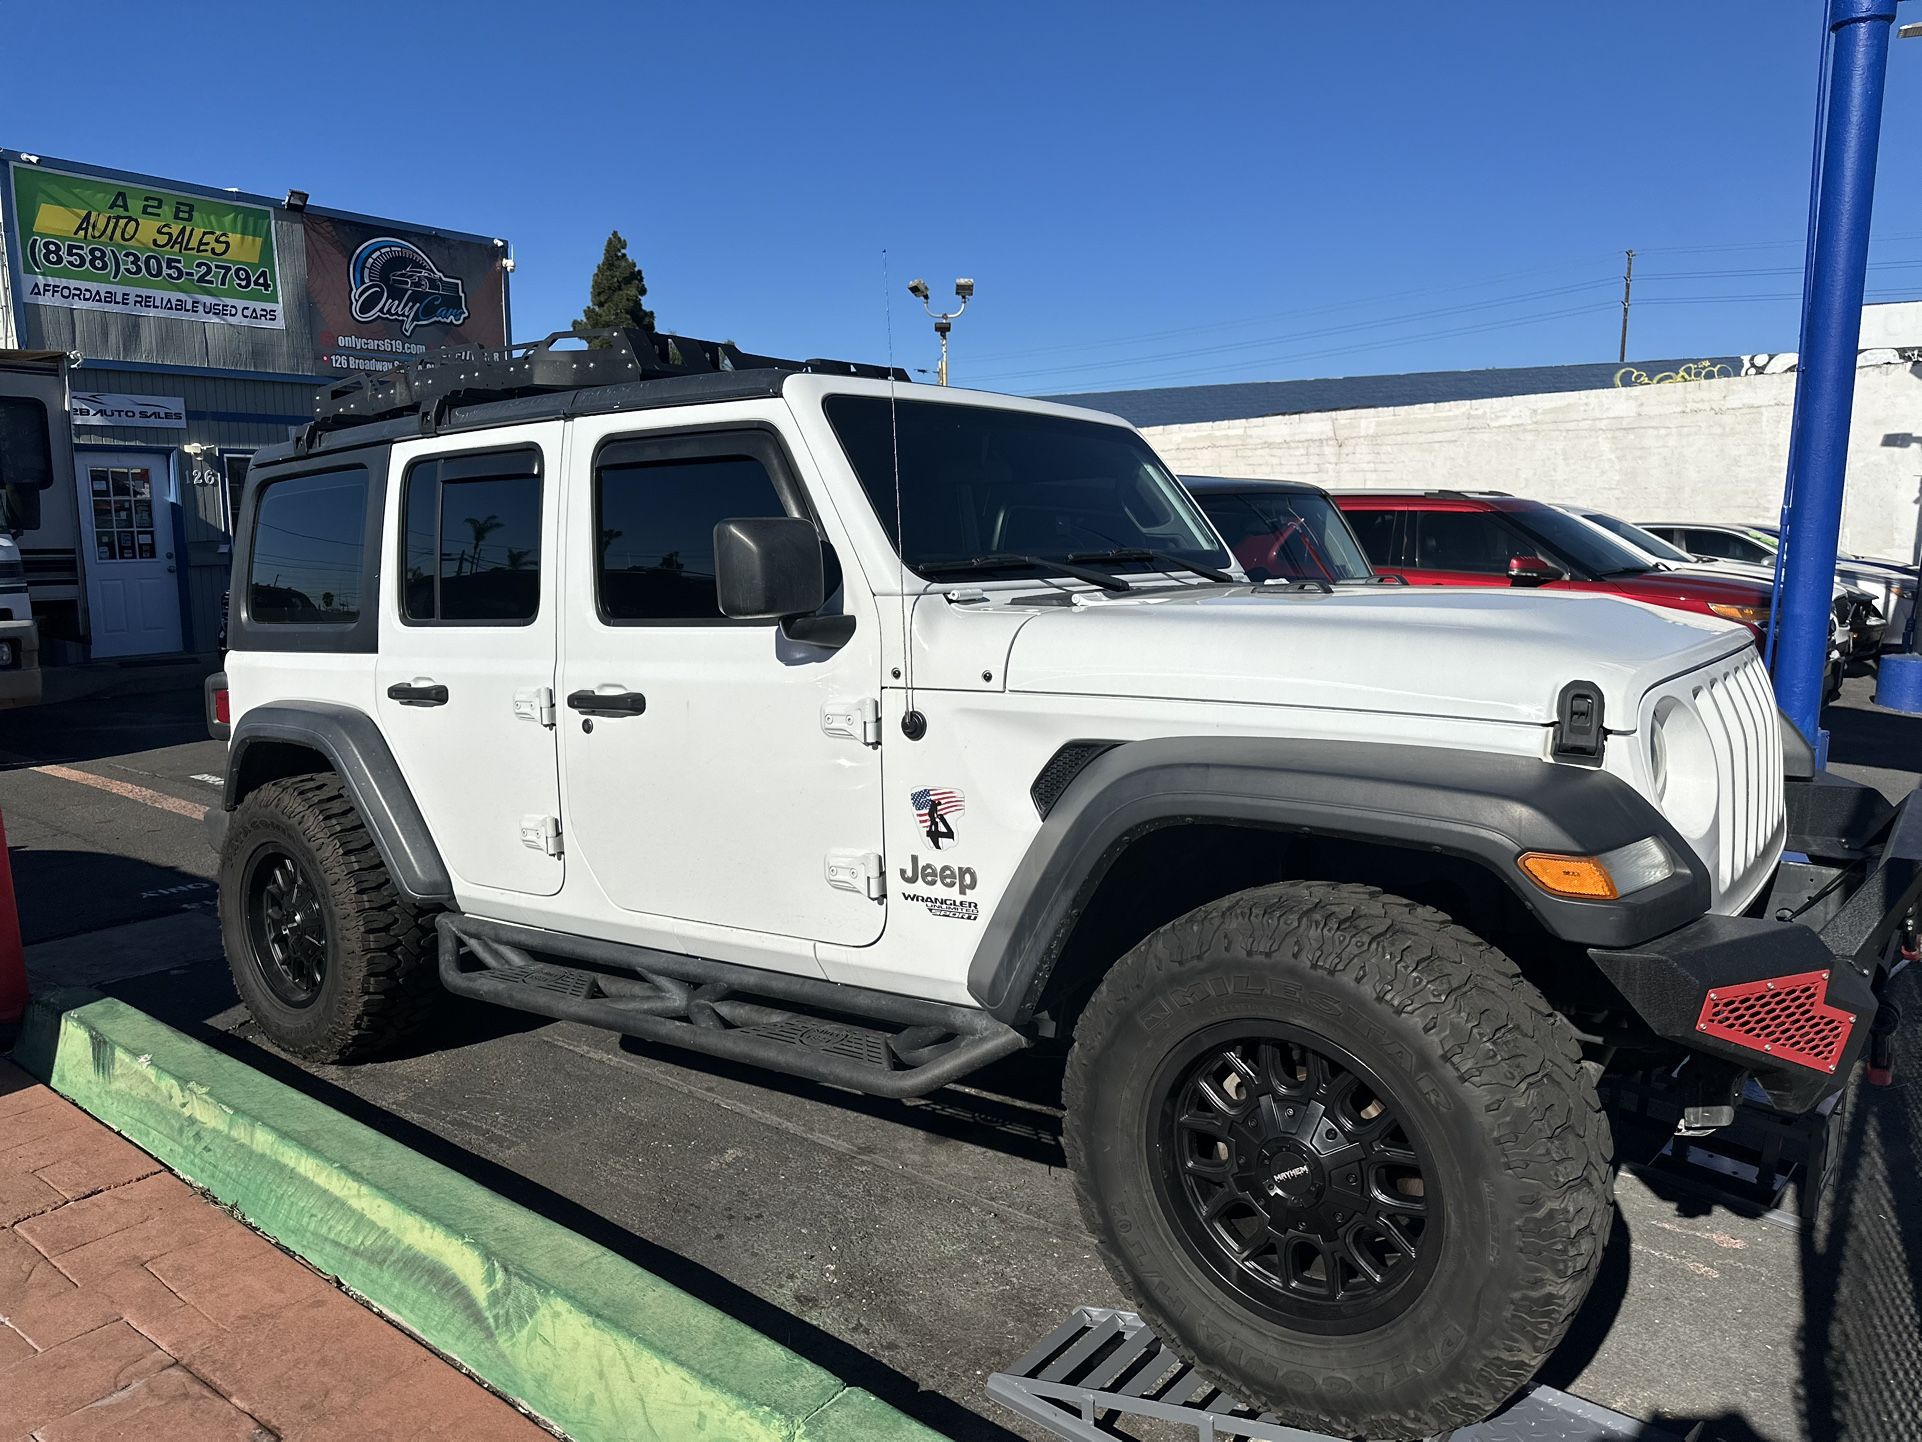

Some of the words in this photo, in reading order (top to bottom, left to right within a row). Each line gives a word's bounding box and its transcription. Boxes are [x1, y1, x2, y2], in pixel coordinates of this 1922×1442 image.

[73, 210, 141, 242] AUTO
[152, 223, 232, 257] SALES
[28, 236, 273, 293] (858)305-2794
[29, 281, 131, 306] AFFORDABLE
[134, 293, 200, 315] RELIABLE
[202, 302, 239, 318] USED
[241, 306, 278, 322] CARS
[337, 335, 426, 355] onlycars619.com
[330, 354, 348, 369] 126
[92, 409, 136, 418] AUTO
[139, 410, 183, 420] SALES
[899, 854, 978, 896] Jeep
[901, 892, 979, 910] WRANGLER
[930, 909, 979, 921] SPORT
[1170, 973, 1457, 1113] MILESTAR
[1273, 1164, 1310, 1183] MAYHEM
